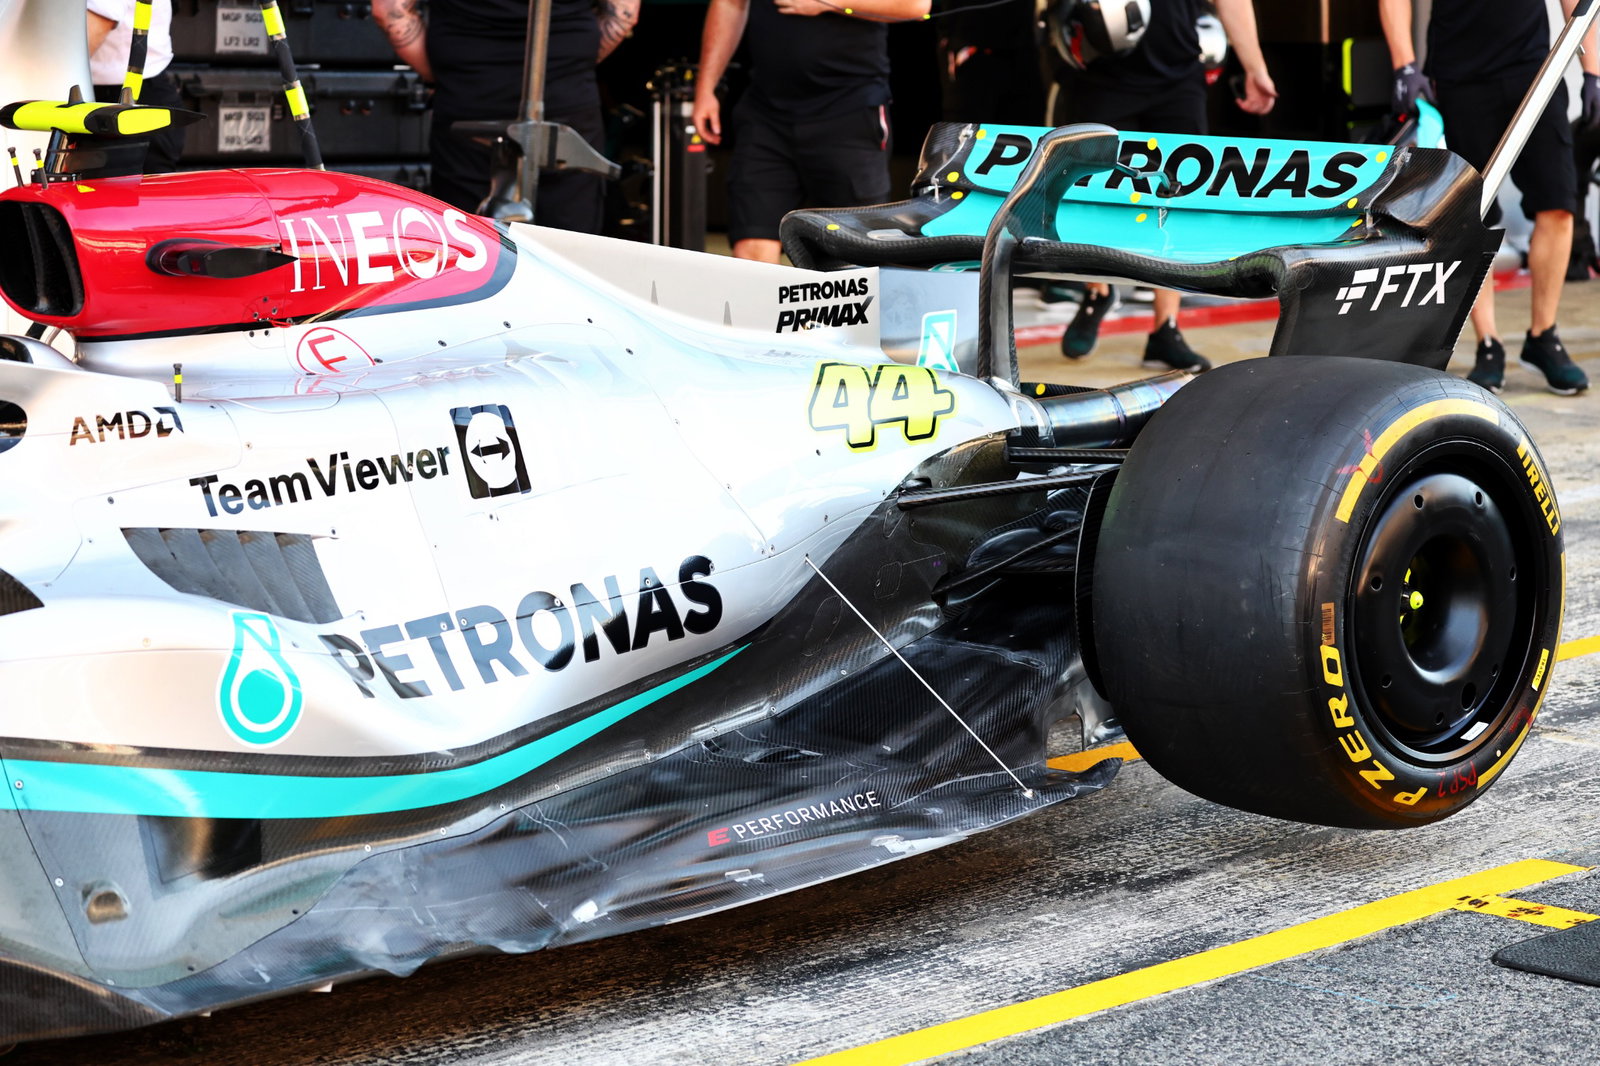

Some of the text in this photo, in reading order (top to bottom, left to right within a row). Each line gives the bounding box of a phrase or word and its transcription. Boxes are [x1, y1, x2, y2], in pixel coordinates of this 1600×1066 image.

[974, 132, 1368, 199] PRONAS
[280, 206, 488, 293] INEOS
[775, 295, 875, 334] PRIMAX
[778, 277, 869, 304] PETRONAS
[1369, 260, 1462, 311] FTX
[69, 410, 152, 446] AMD
[808, 359, 959, 453] 44
[189, 445, 451, 518] TeamViewer
[318, 554, 723, 700] PETRONAS
[1320, 644, 1428, 806] P ZERO
[732, 790, 881, 839] PERFORMANCE
